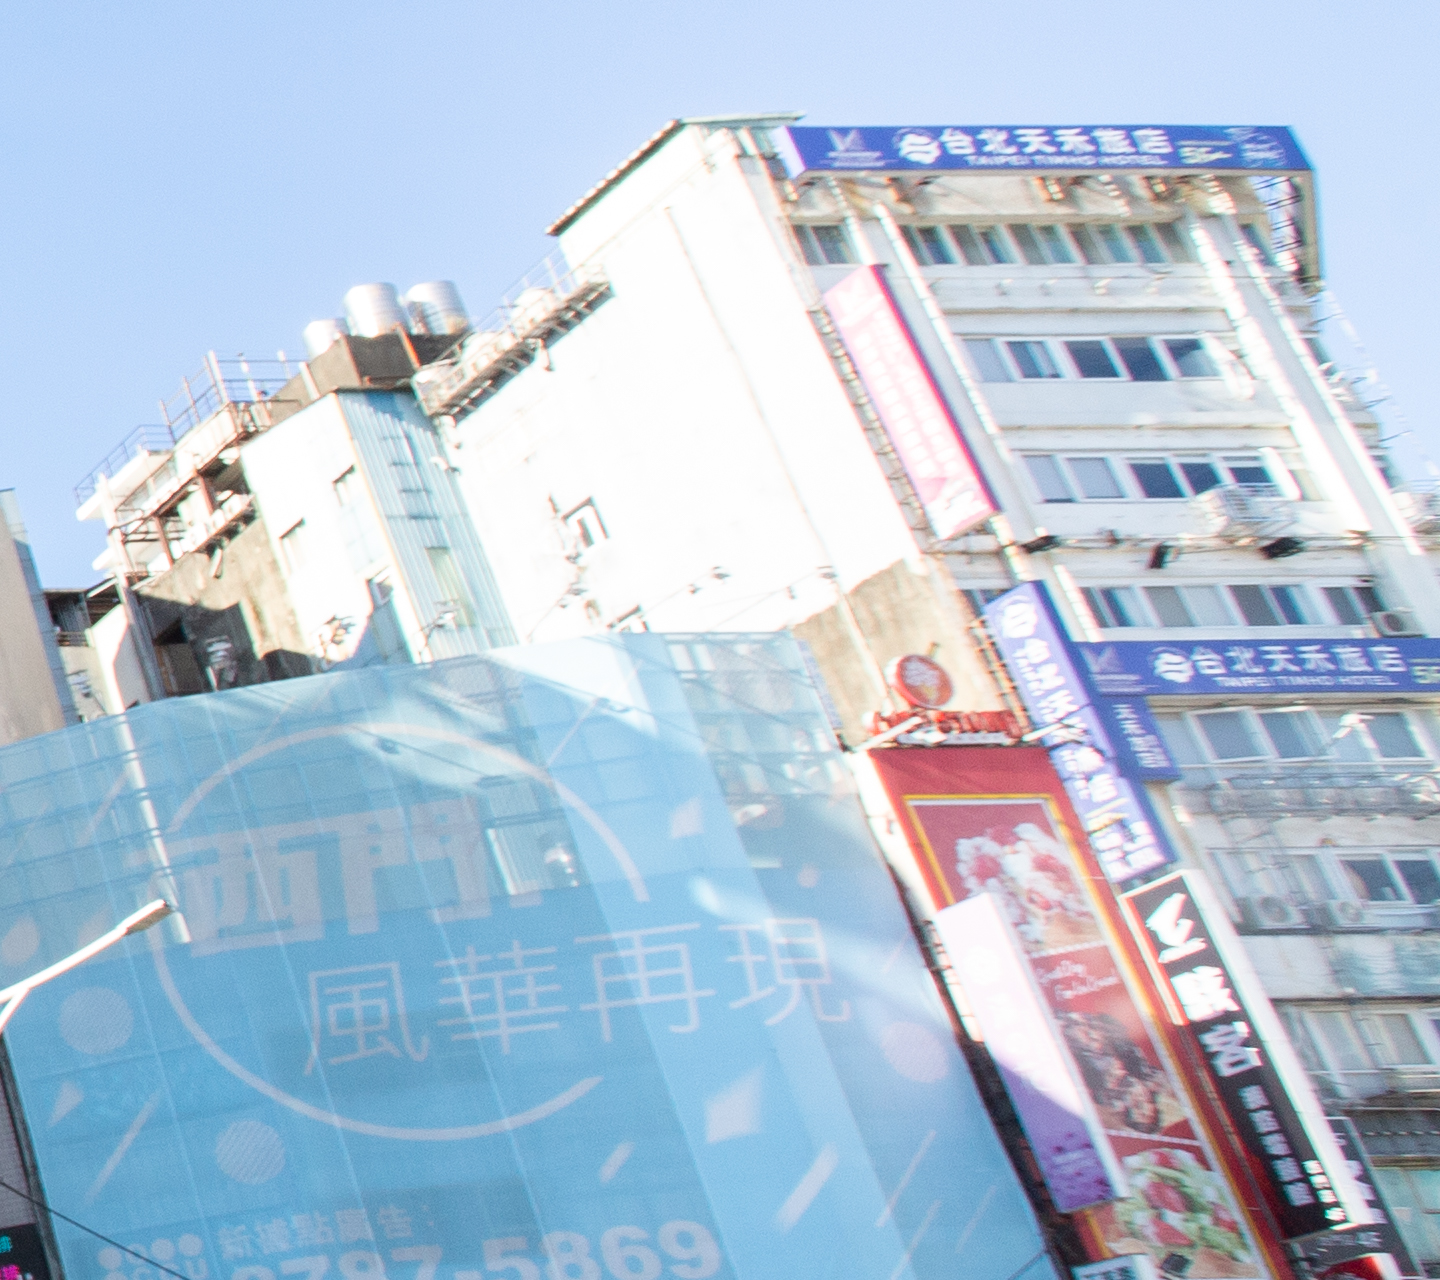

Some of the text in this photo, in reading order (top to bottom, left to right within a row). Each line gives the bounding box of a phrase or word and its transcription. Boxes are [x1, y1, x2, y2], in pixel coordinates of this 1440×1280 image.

[1100, 155, 1169, 166] HOTEL
[305, 918, 853, 1076] 風華再現
